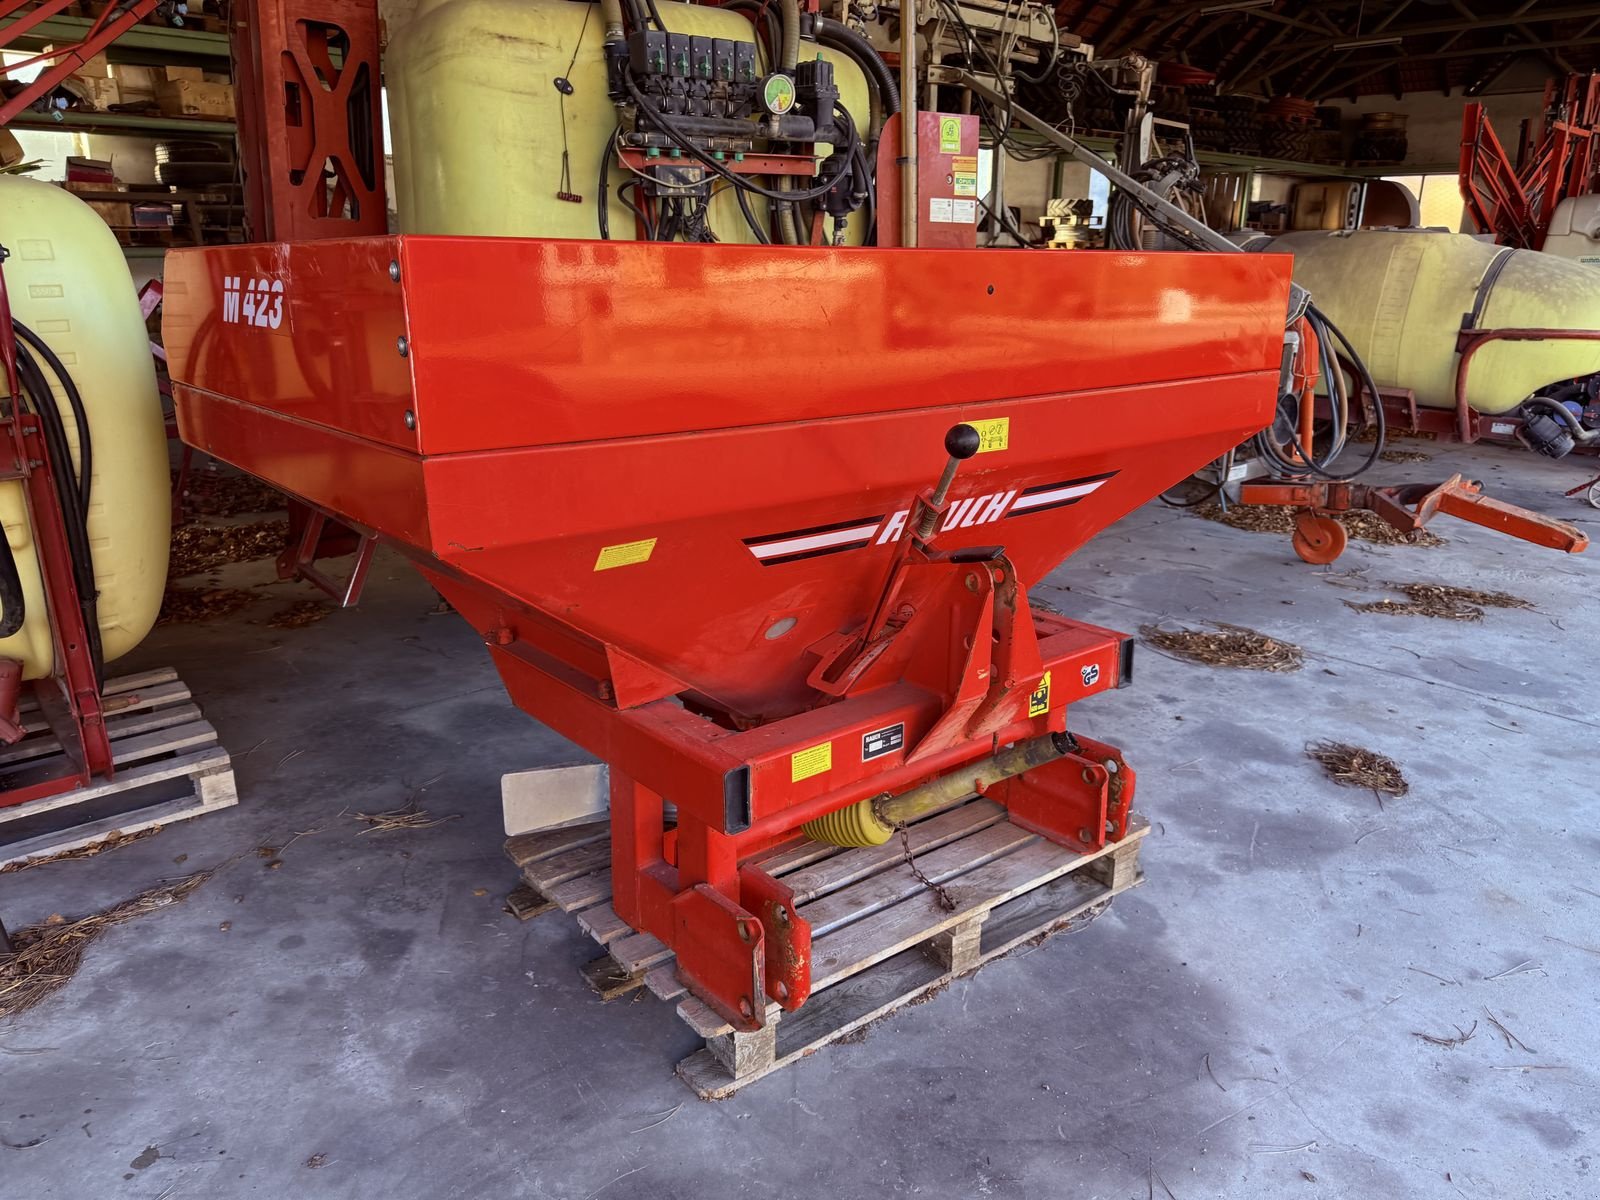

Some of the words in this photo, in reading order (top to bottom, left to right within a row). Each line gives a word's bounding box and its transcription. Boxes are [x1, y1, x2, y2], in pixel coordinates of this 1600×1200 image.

[223, 276, 241, 324] M
[242, 278, 284, 330] 423
[875, 489, 1017, 545] RUCH
